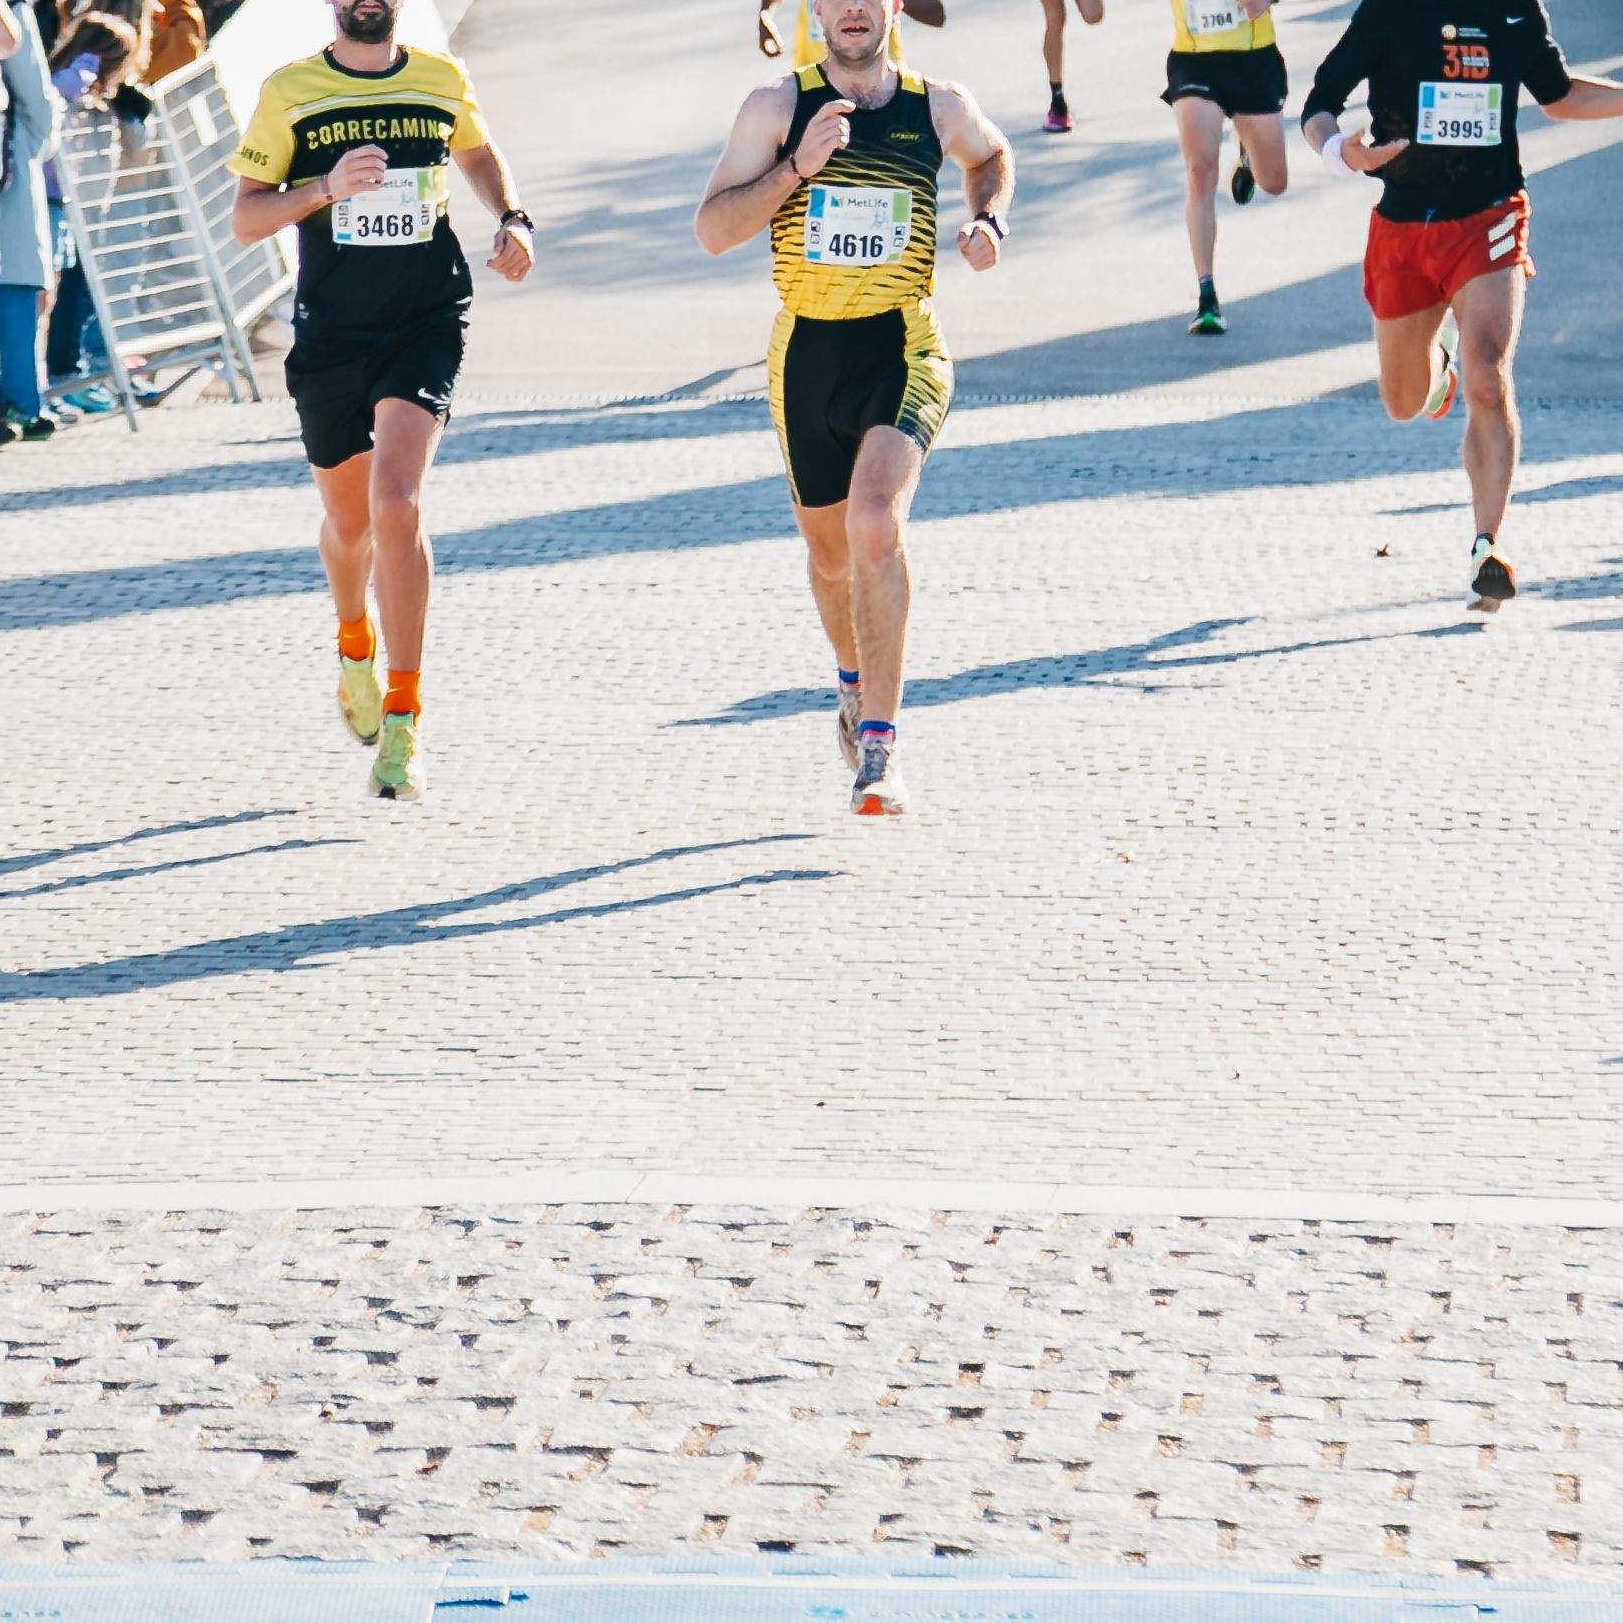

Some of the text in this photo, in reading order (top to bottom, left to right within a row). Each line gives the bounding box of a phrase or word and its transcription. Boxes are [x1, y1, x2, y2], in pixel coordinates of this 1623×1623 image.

[1438, 120, 1483, 138] 3995
[381, 176, 414, 189] etLife
[847, 196, 889, 209] MetLife
[357, 214, 414, 238] 3468
[829, 234, 883, 258] 4616
